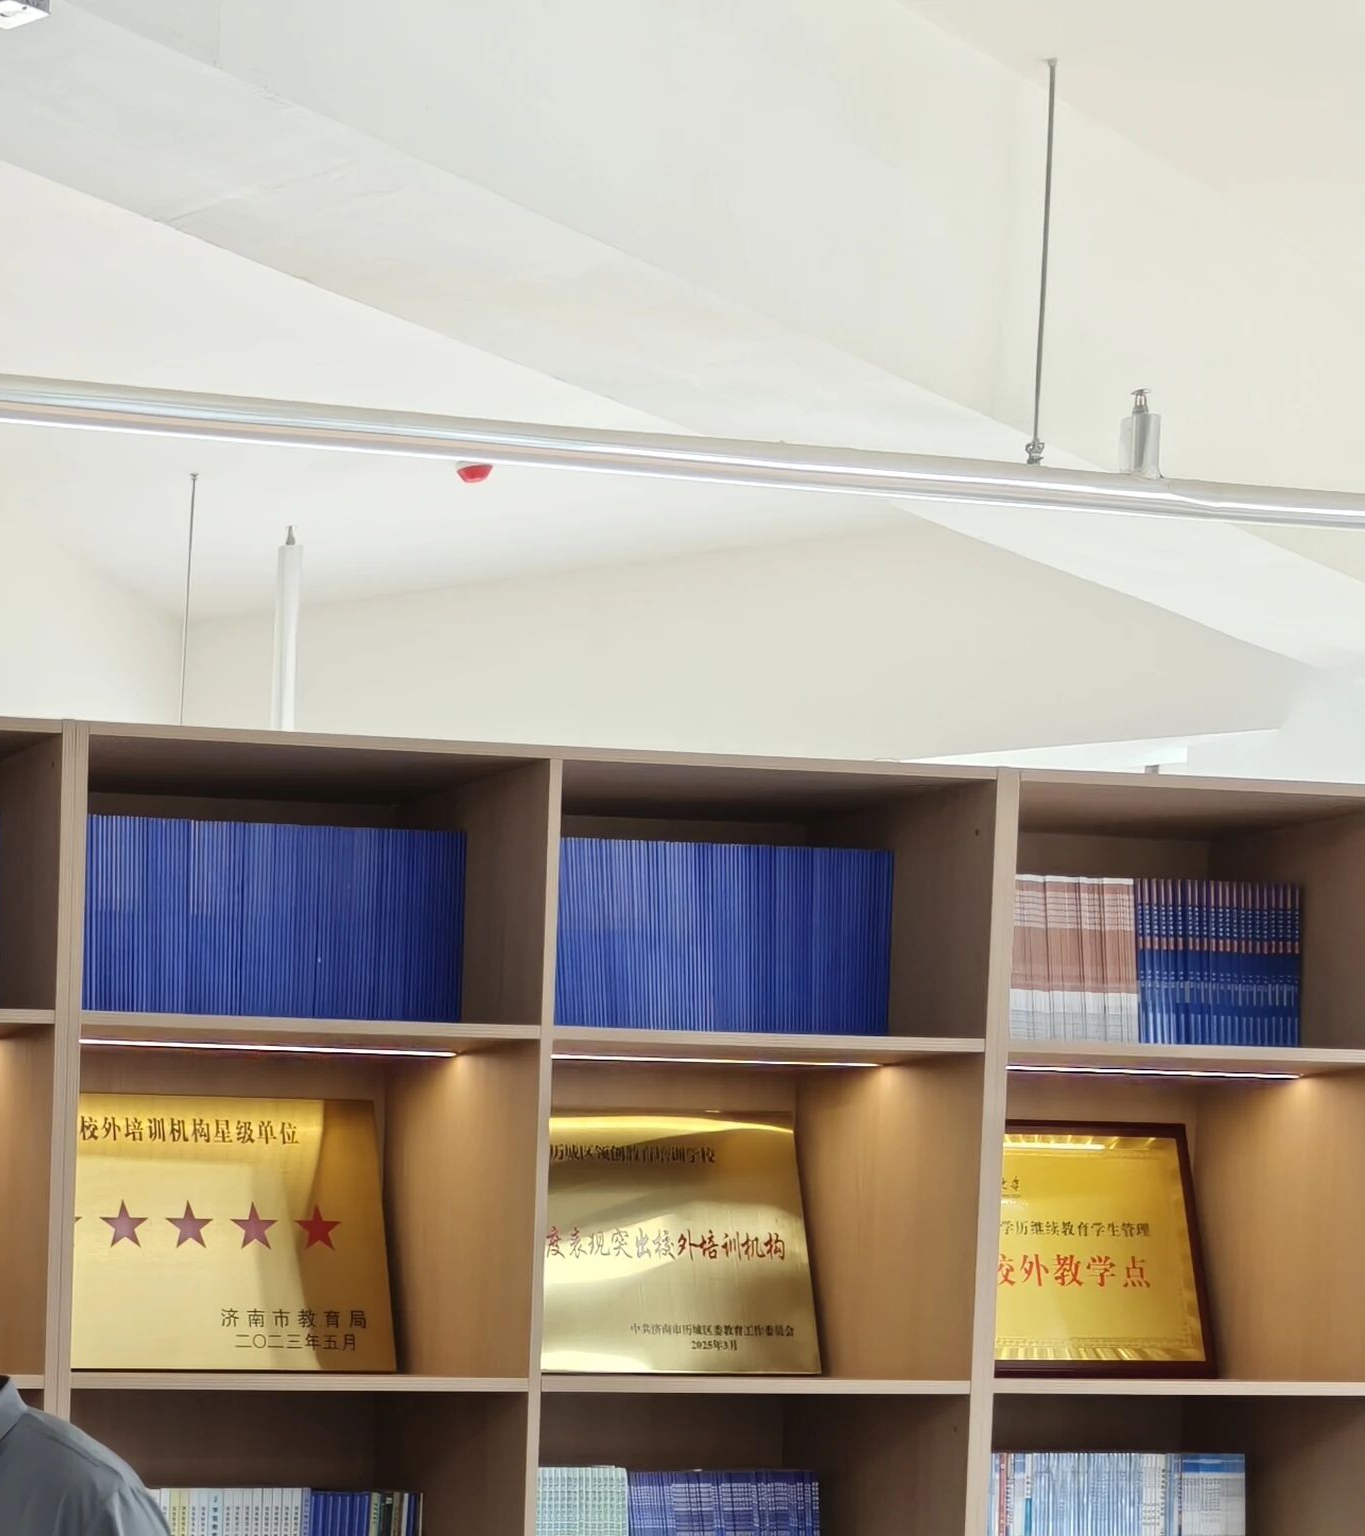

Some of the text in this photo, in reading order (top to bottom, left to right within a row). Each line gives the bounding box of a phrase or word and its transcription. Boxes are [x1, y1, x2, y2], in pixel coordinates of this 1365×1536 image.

[80, 1115, 300, 1145] 校外培训机构星级单位
[221, 1308, 368, 1330] 济南市教育局
